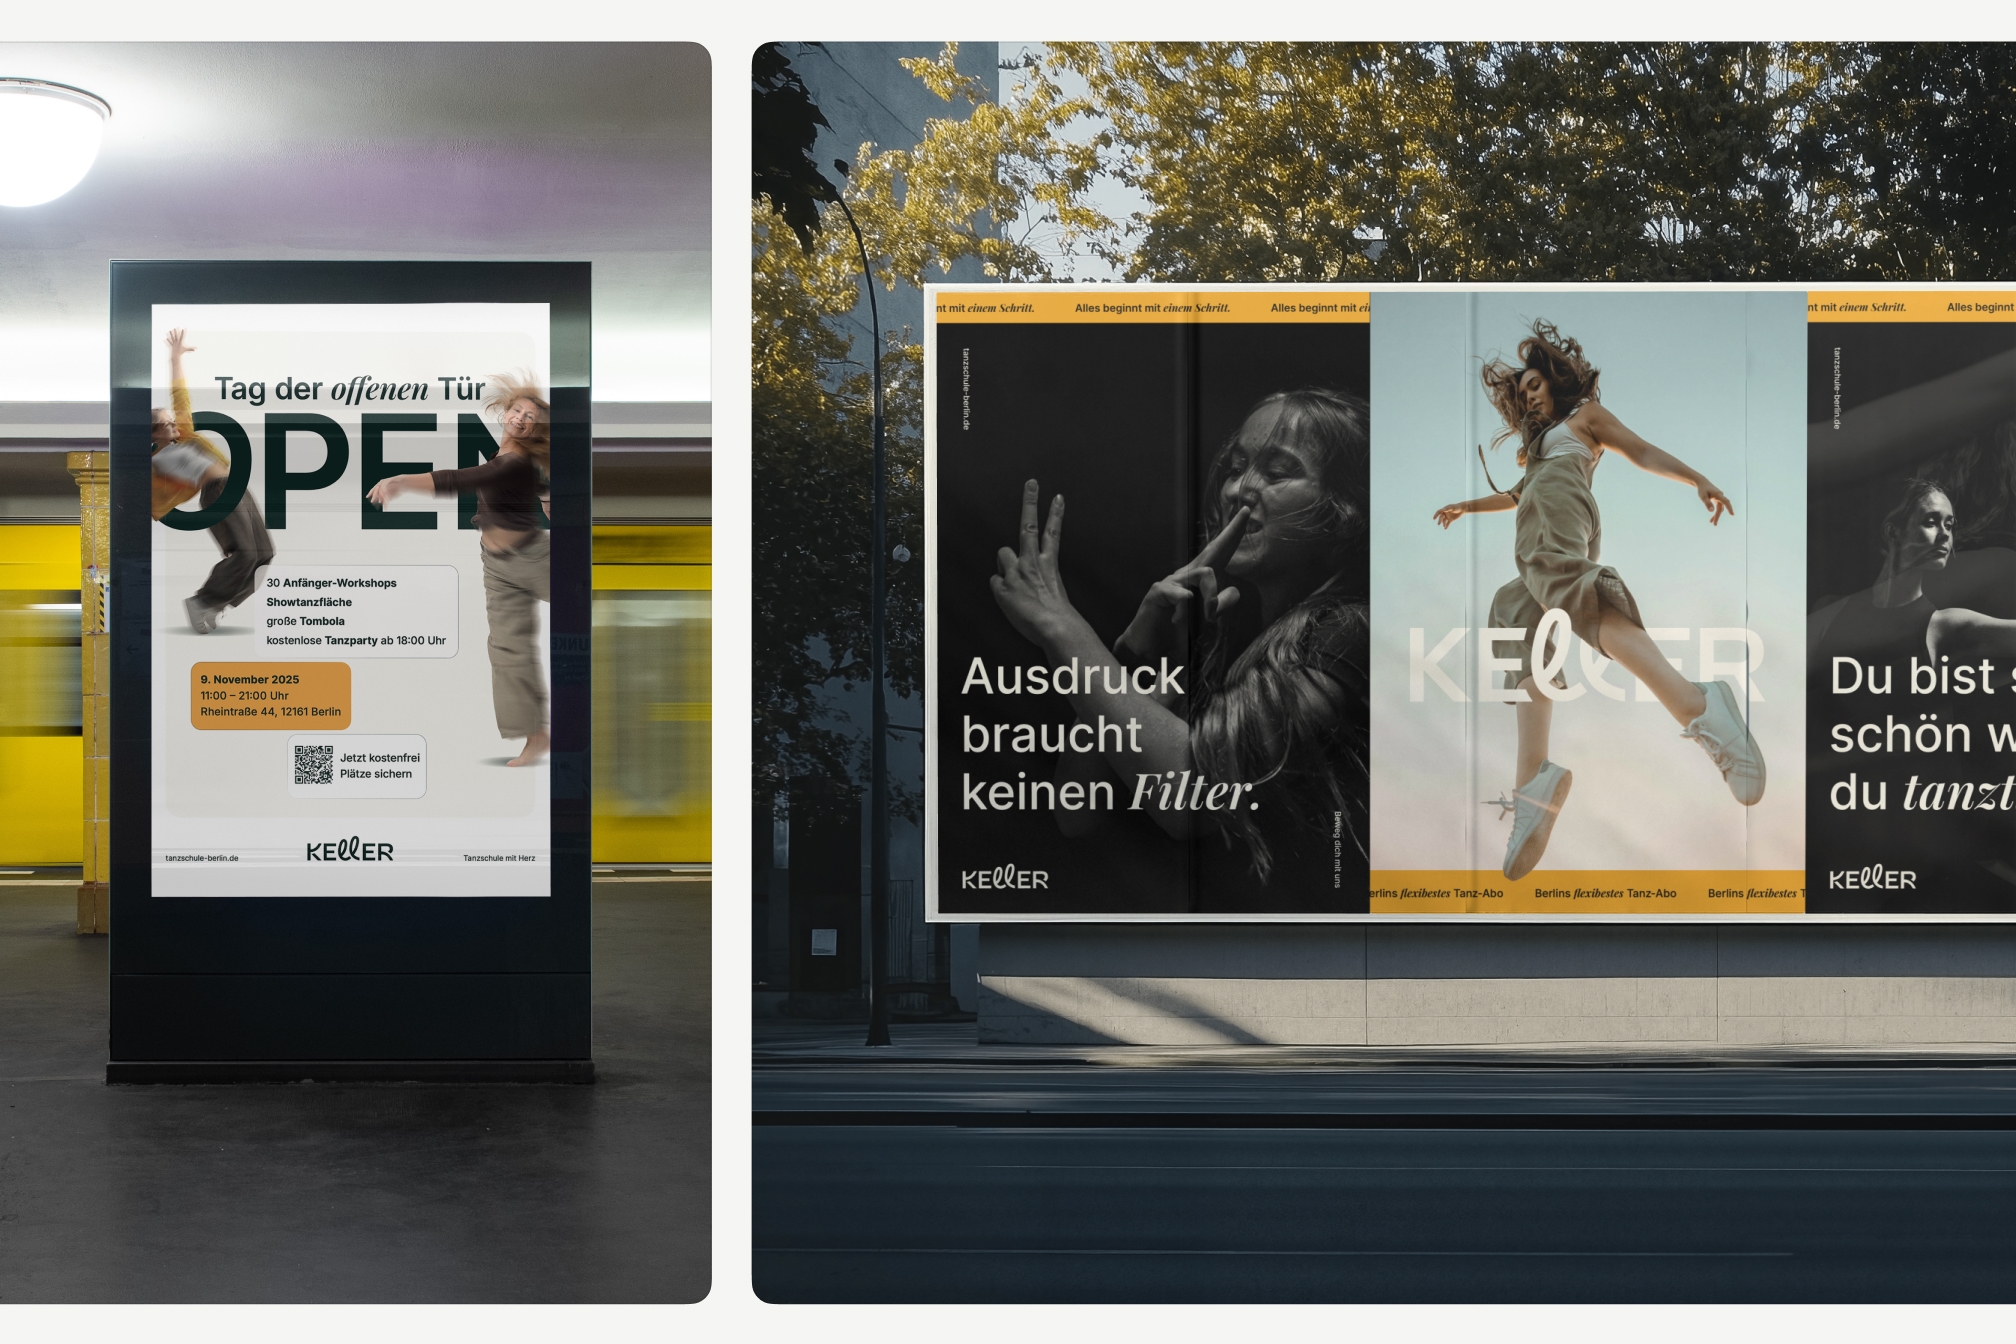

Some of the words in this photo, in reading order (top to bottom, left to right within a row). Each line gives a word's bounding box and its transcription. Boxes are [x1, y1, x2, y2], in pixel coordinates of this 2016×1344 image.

[949, 303, 966, 313] mit
[967, 303, 997, 313] einem
[998, 302, 1035, 313] Schritt.
[1074, 303, 1100, 313] Alles
[1103, 303, 1142, 315] beginnt
[1144, 303, 1161, 313] mit
[1162, 303, 1192, 313] einem
[1194, 303, 1231, 313] Schritt.
[1271, 303, 1296, 313] Alles
[1299, 303, 1338, 315] beginnt
[1340, 303, 1357, 313] mit
[1820, 302, 1837, 312] mit
[1839, 302, 1869, 312] einem
[1870, 302, 1907, 312] Schritt.
[1947, 302, 1973, 312] Alles
[1975, 302, 2015, 314] beginnt
[214, 376, 266, 407] Tag
[275, 376, 323, 401] der
[331, 374, 429, 406] offenen
[437, 375, 486, 401] Tür
[962, 347, 971, 431] tanzschule-berlin.de
[1833, 346, 1842, 430] tanzschule-berlin.de
[266, 578, 280, 588] 30
[283, 578, 397, 590] Anfänger-Workshops
[266, 597, 353, 607] Showtanzfläche
[266, 616, 297, 628] große
[299, 616, 345, 626] Tombola
[266, 635, 322, 645] kostenlose
[324, 635, 379, 647] Tanzparty
[380, 635, 394, 645] ab
[396, 635, 425, 645] 18:00
[427, 635, 447, 645] Uhr
[200, 674, 211, 684] 9.
[213, 674, 269, 684] November
[271, 674, 300, 684] 2025
[961, 656, 1185, 695] Ausdruck
[1832, 656, 1892, 695] Du
[1910, 655, 1995, 695] bist
[200, 690, 227, 701] 11:00
[238, 690, 267, 701] 21:00
[270, 690, 289, 701] Uhr
[200, 706, 258, 716] Rheintraße
[260, 706, 278, 718] 44,
[281, 706, 308, 716] 12161
[311, 706, 341, 716] Berlin
[962, 714, 1142, 753] braucht
[1830, 713, 1971, 753] schön
[340, 753, 367, 763] Jetzt
[369, 752, 421, 763] kostenfrei
[340, 768, 372, 779] Plätze
[374, 768, 413, 779] sichern
[962, 771, 1114, 811] keinen
[1127, 769, 1260, 812] Filter.
[1830, 772, 1887, 811] du
[1332, 811, 1342, 839] Beweg
[1334, 840, 1342, 858] dich
[165, 854, 239, 862] tanzschule-berlin.de
[463, 854, 504, 862] Tanzschule
[505, 854, 517, 862] mit
[518, 854, 536, 862] Herz
[1334, 859, 1342, 872] mit
[1400, 887, 1451, 900] flexibestes
[1453, 888, 1504, 898] Tanz-Abo
[1535, 888, 1571, 898] Berlins
[1573, 887, 1624, 900] flexibestes
[1626, 888, 1677, 898] Tanz-Abo
[1708, 888, 1744, 898] Berlins
[1746, 887, 1797, 900] flexibestes
